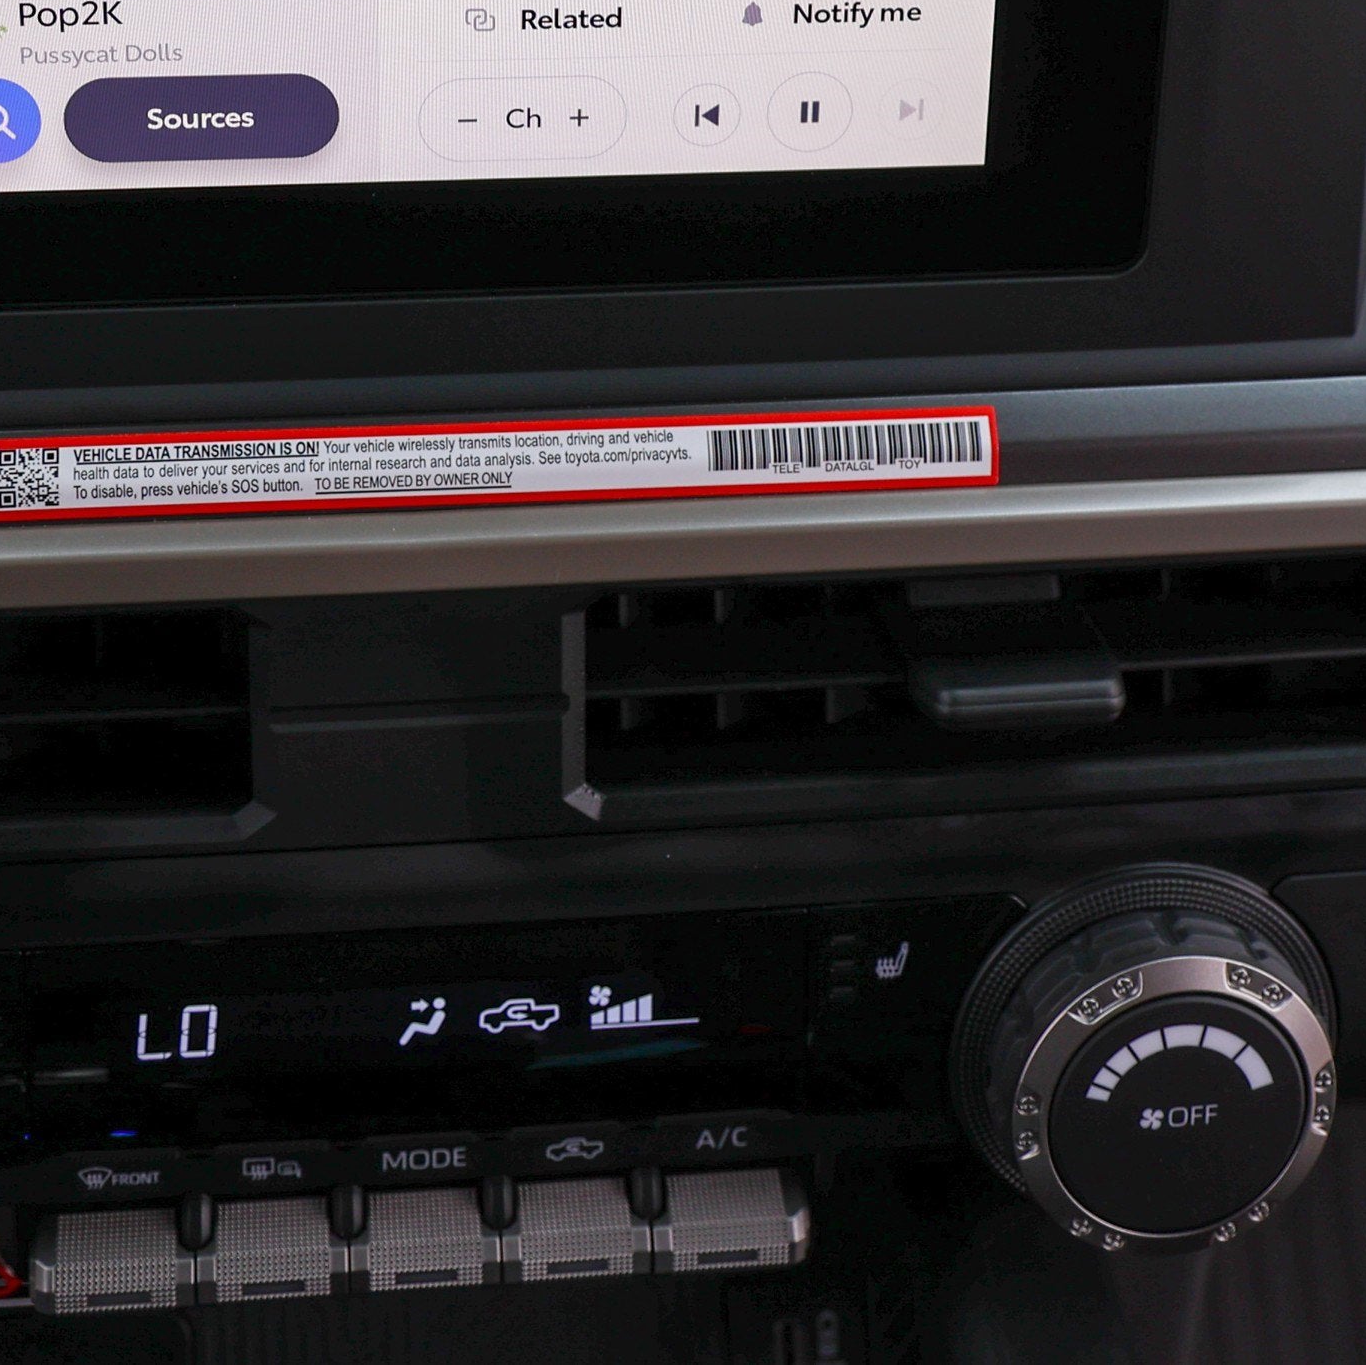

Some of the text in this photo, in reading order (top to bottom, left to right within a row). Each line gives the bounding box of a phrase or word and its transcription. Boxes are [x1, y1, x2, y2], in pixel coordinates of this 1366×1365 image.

[18, 1, 123, 32] Pop2K
[521, 7, 623, 32] Related
[793, 1, 922, 27] Notify me
[20, 43, 184, 69] Pussycat Dolls
[146, 108, 255, 131] Sources
[506, 107, 542, 129] Ch
[73, 429, 673, 463] VEHICLE DATA TRANSMISSION IS ON! Your vehicle wirelessly transmits location, driving and vehicle
[73, 447, 692, 480] health data to deliver your services and for internal research and data analysis. See toyota.com/privacyvts.
[772, 458, 922, 474] TELE DATALGL TOY
[73, 471, 513, 500] To disable, press vehicle's SOS button. TO BE REMOVED BY OWNER ONLY
[1167, 1104, 1218, 1128] OFF
[696, 1127, 749, 1150] A/C
[381, 1147, 468, 1171] MODE
[111, 1170, 160, 1186] FRONT
